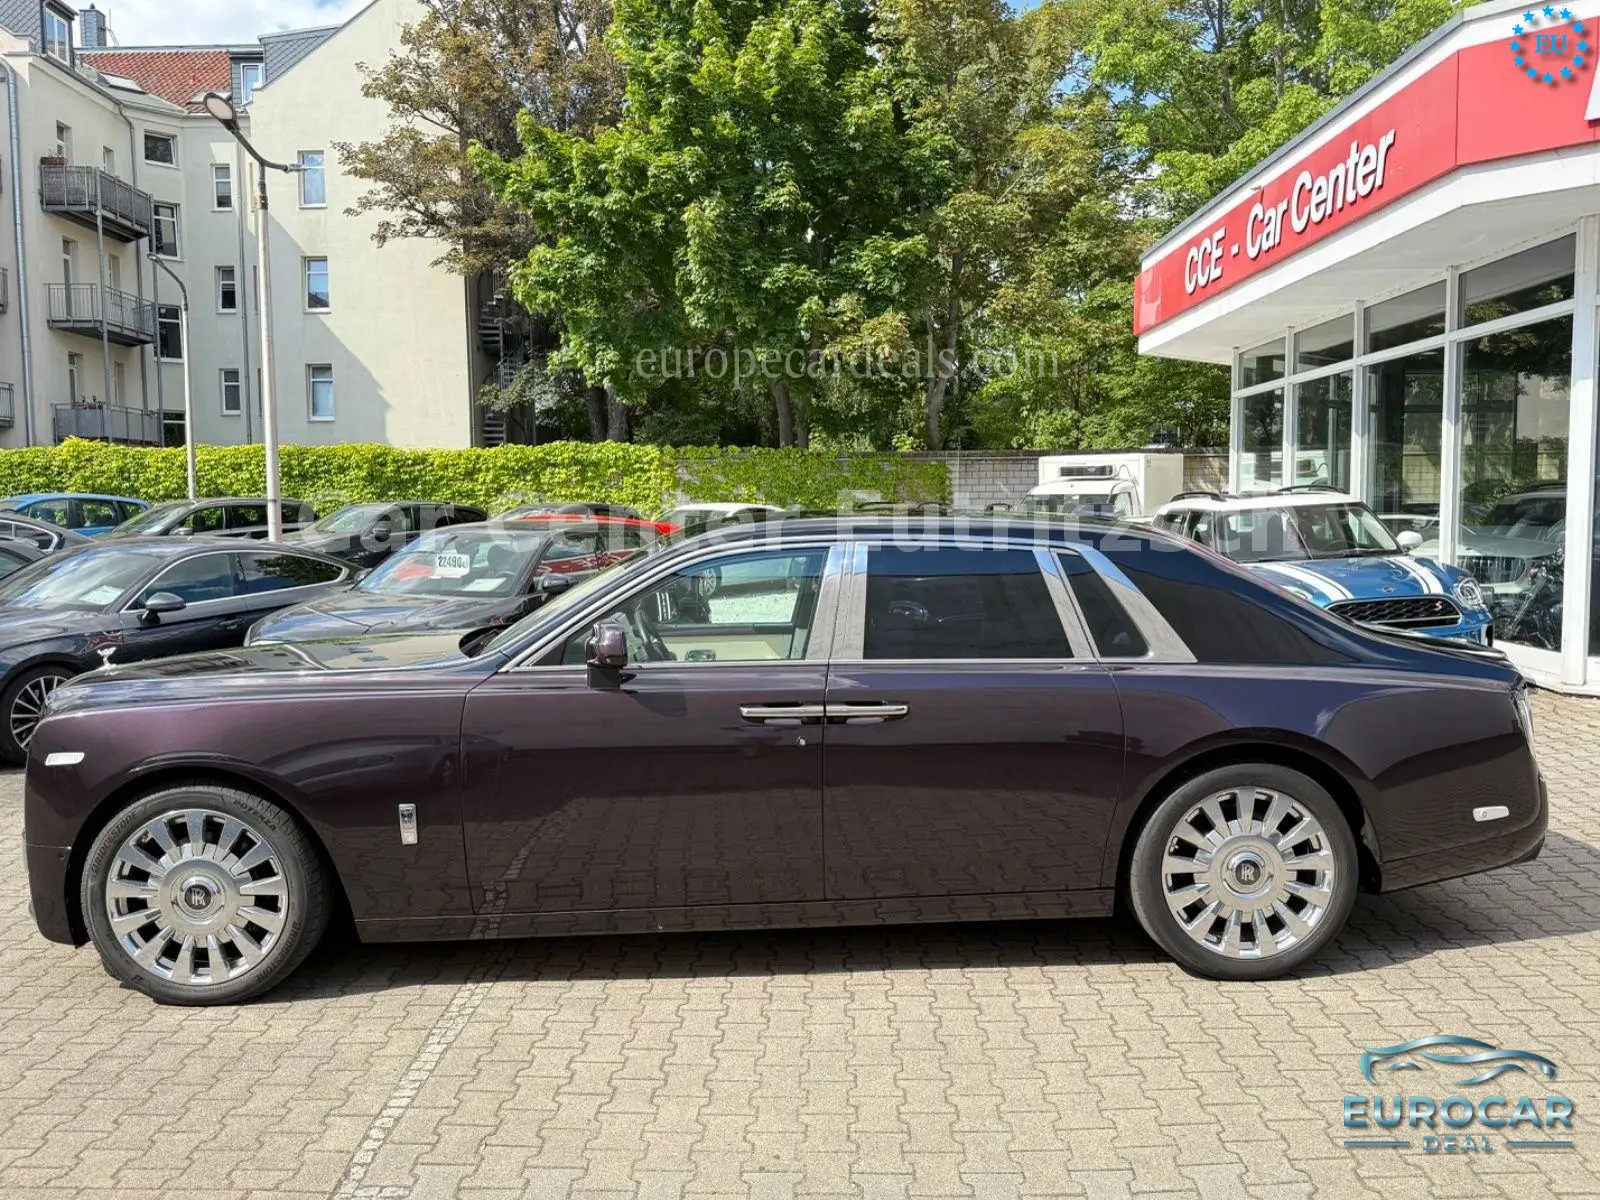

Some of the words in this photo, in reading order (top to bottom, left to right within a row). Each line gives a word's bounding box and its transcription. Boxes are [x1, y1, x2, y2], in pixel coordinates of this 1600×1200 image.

[1184, 227, 1227, 295] CCE
[1246, 196, 1289, 261] Car
[1290, 128, 1396, 234] Center
